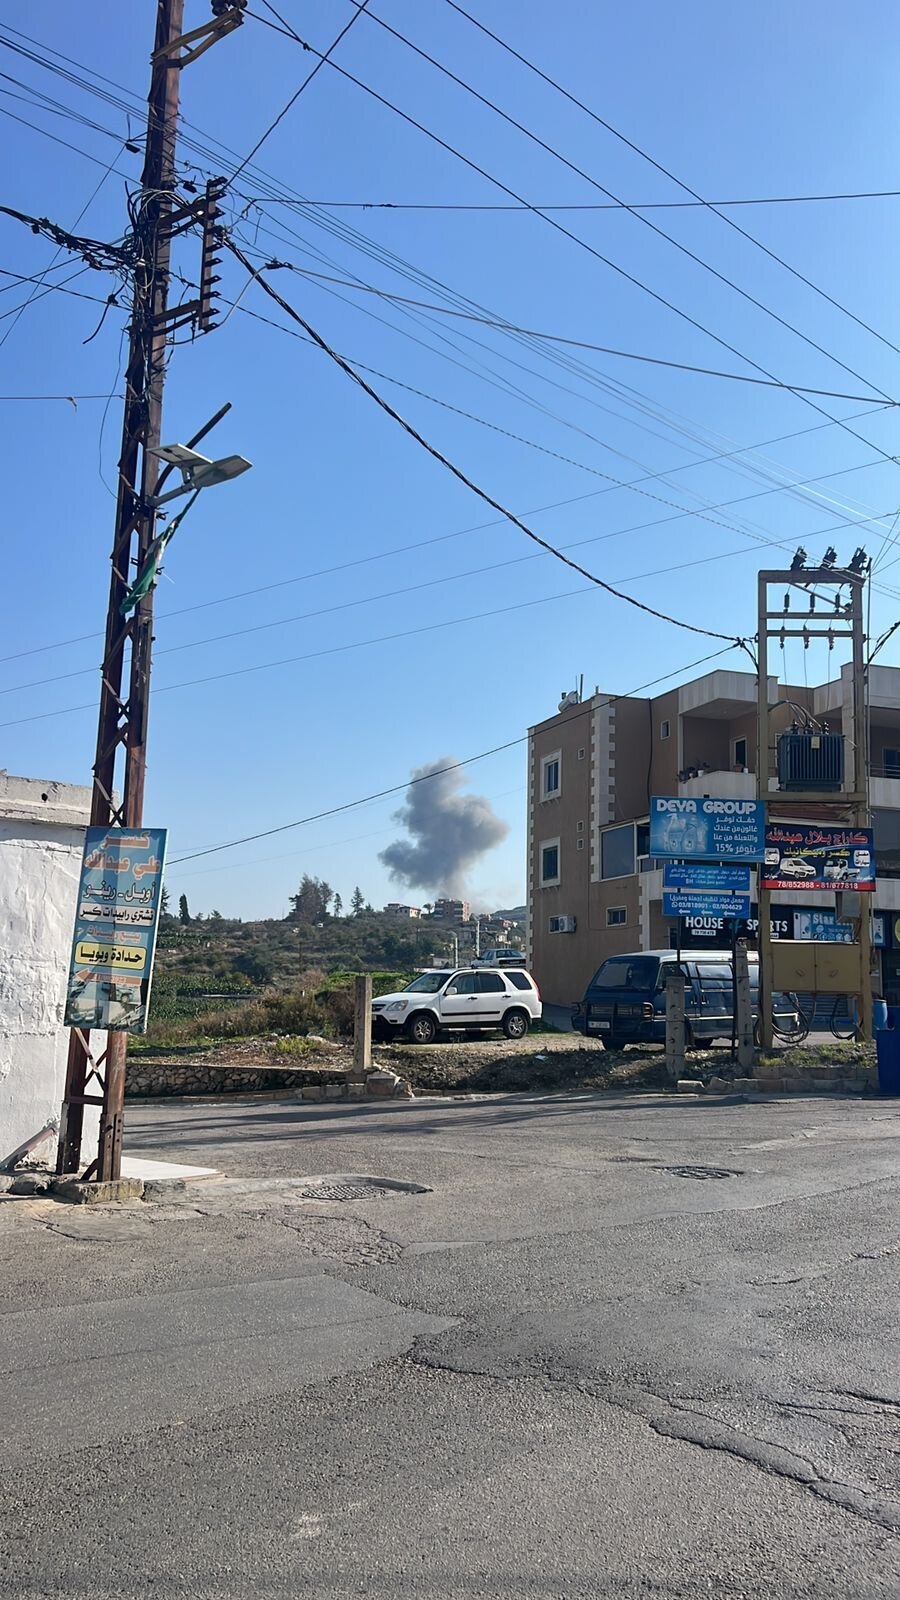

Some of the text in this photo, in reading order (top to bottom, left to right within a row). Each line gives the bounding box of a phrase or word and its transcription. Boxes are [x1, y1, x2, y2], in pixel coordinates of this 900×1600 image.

[656, 799, 757, 815] DEYA GROUP
[805, 830, 832, 845] بلال
[715, 843, 734, 853] 15%
[685, 916, 788, 932] HOUSE SPRTS
[111, 947, 143, 964] حدادة
